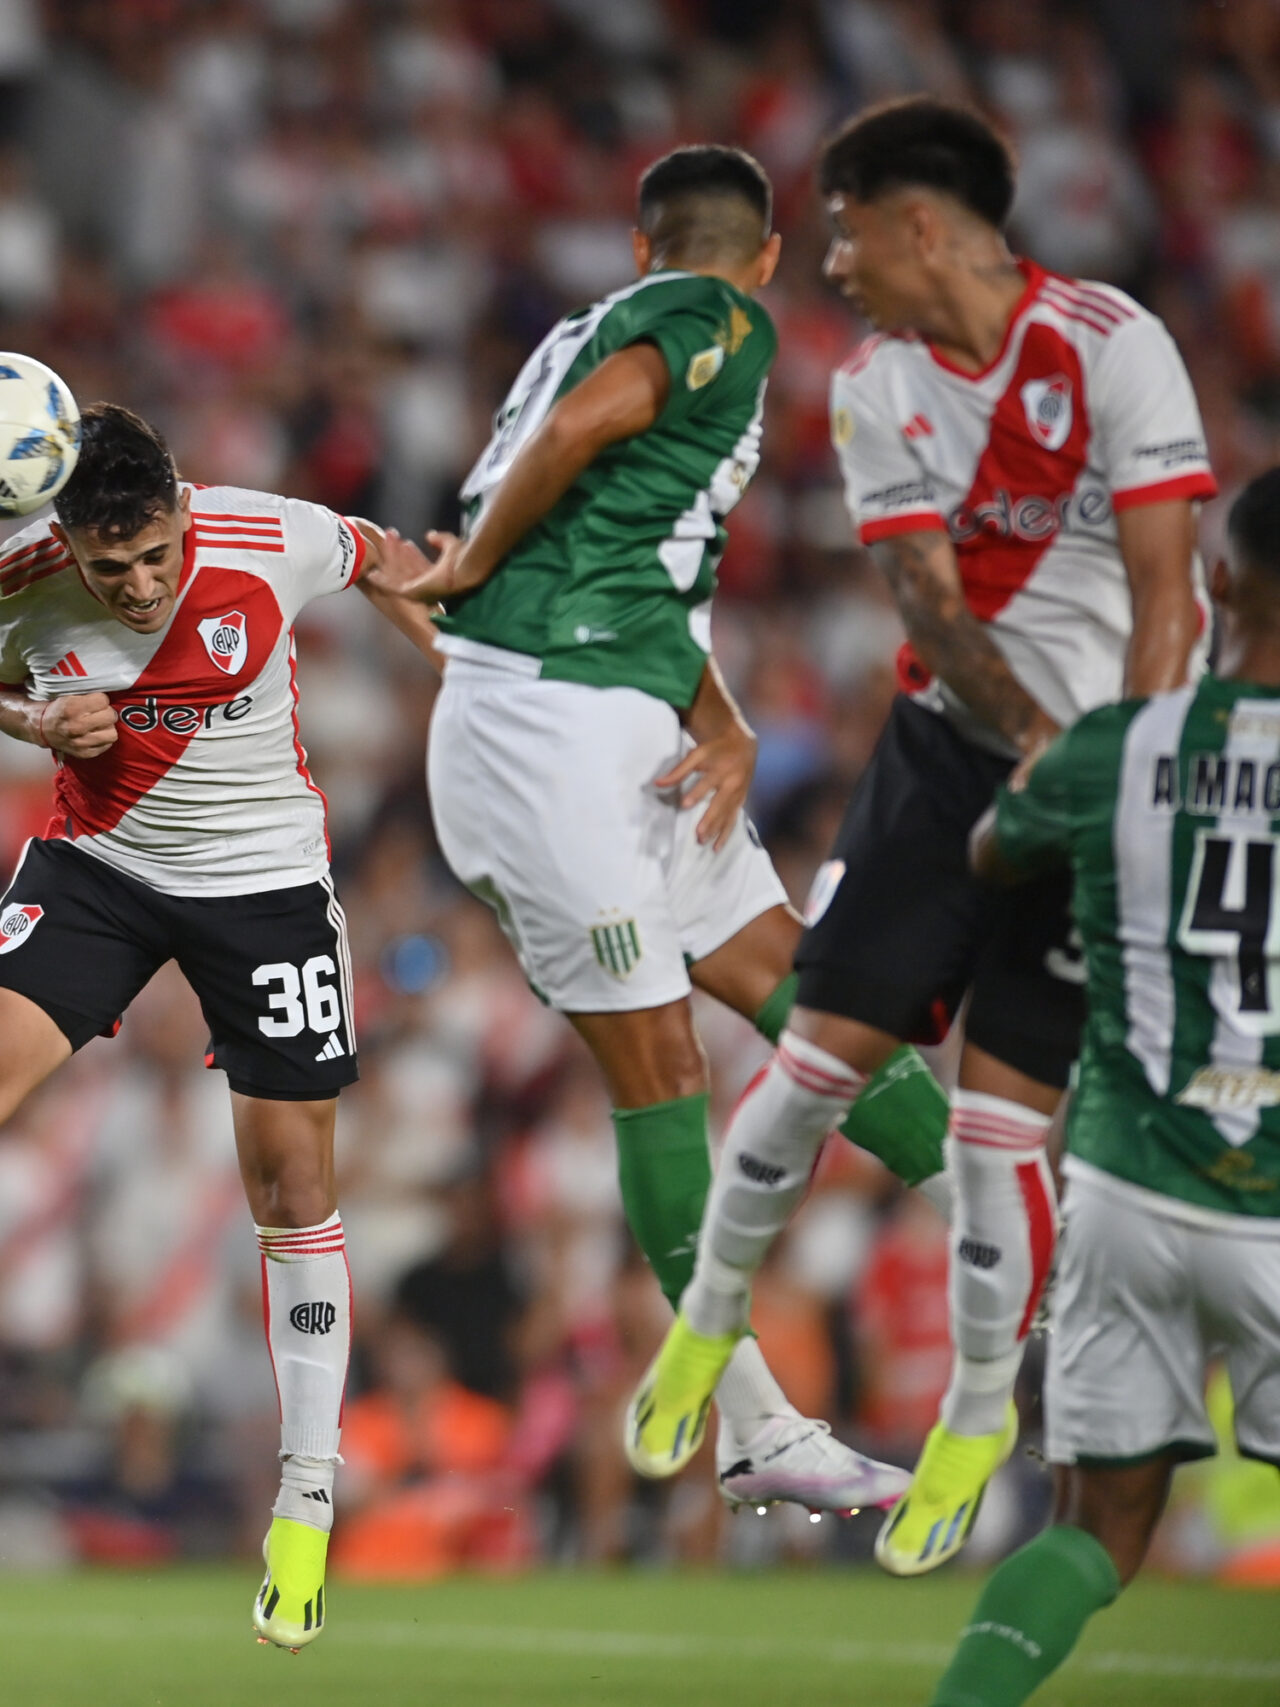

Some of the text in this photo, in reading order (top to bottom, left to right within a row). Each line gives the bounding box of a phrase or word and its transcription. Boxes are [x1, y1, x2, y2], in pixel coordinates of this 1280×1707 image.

[950, 487, 1111, 538] odere
[211, 626, 240, 655] CARP
[120, 695, 254, 734] dere
[1184, 835, 1278, 1020] 4
[251, 954, 341, 1038] 36
[289, 1301, 336, 1335] CARP
